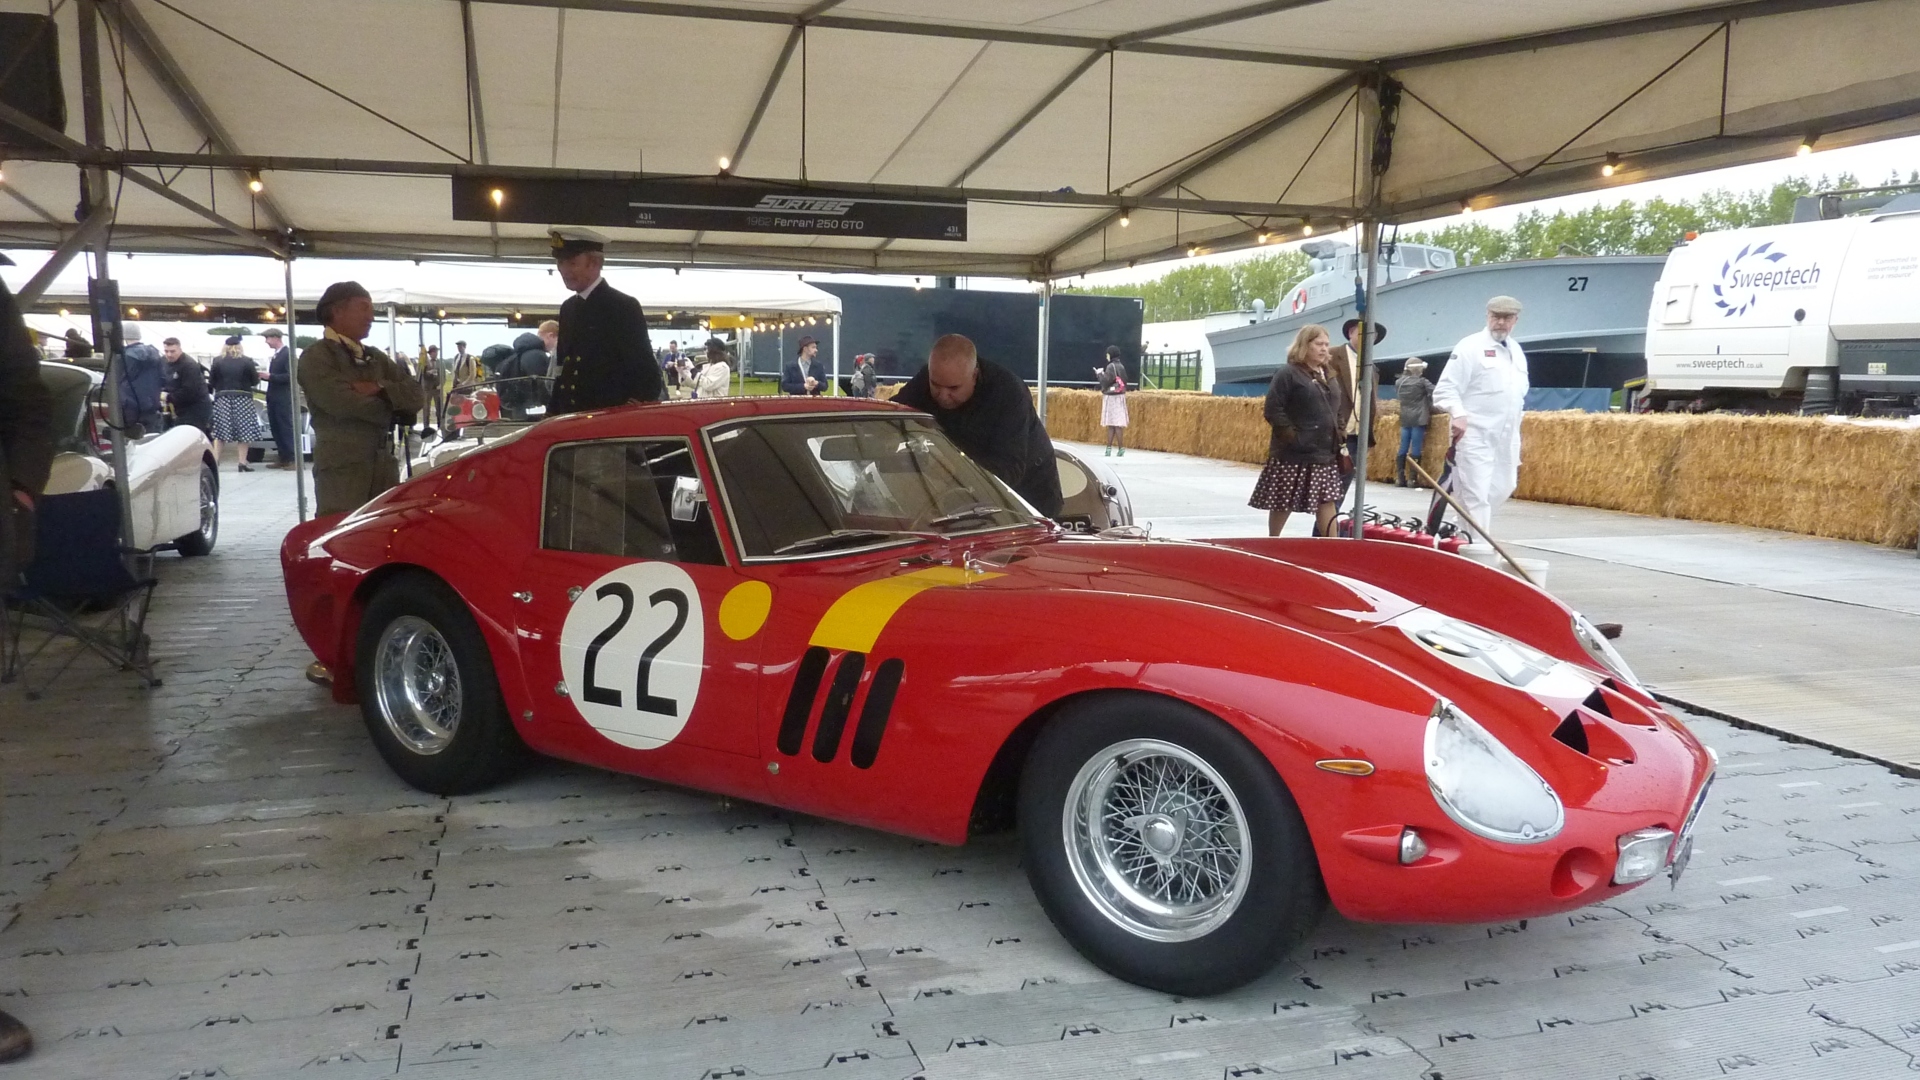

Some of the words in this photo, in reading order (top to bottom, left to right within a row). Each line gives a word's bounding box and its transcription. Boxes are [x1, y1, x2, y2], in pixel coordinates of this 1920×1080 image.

[755, 194, 855, 216] SURTEES
[638, 212, 652, 220] 431
[746, 216, 772, 227] 1962
[774, 217, 814, 229] Ferrari
[816, 219, 839, 229] 250
[841, 220, 864, 230] GTO
[1567, 276, 1589, 292] 27
[1729, 262, 1821, 292] Sweeptech
[1676, 357, 1763, 371] www.sweeptech.co.uk
[583, 581, 690, 718] 22
